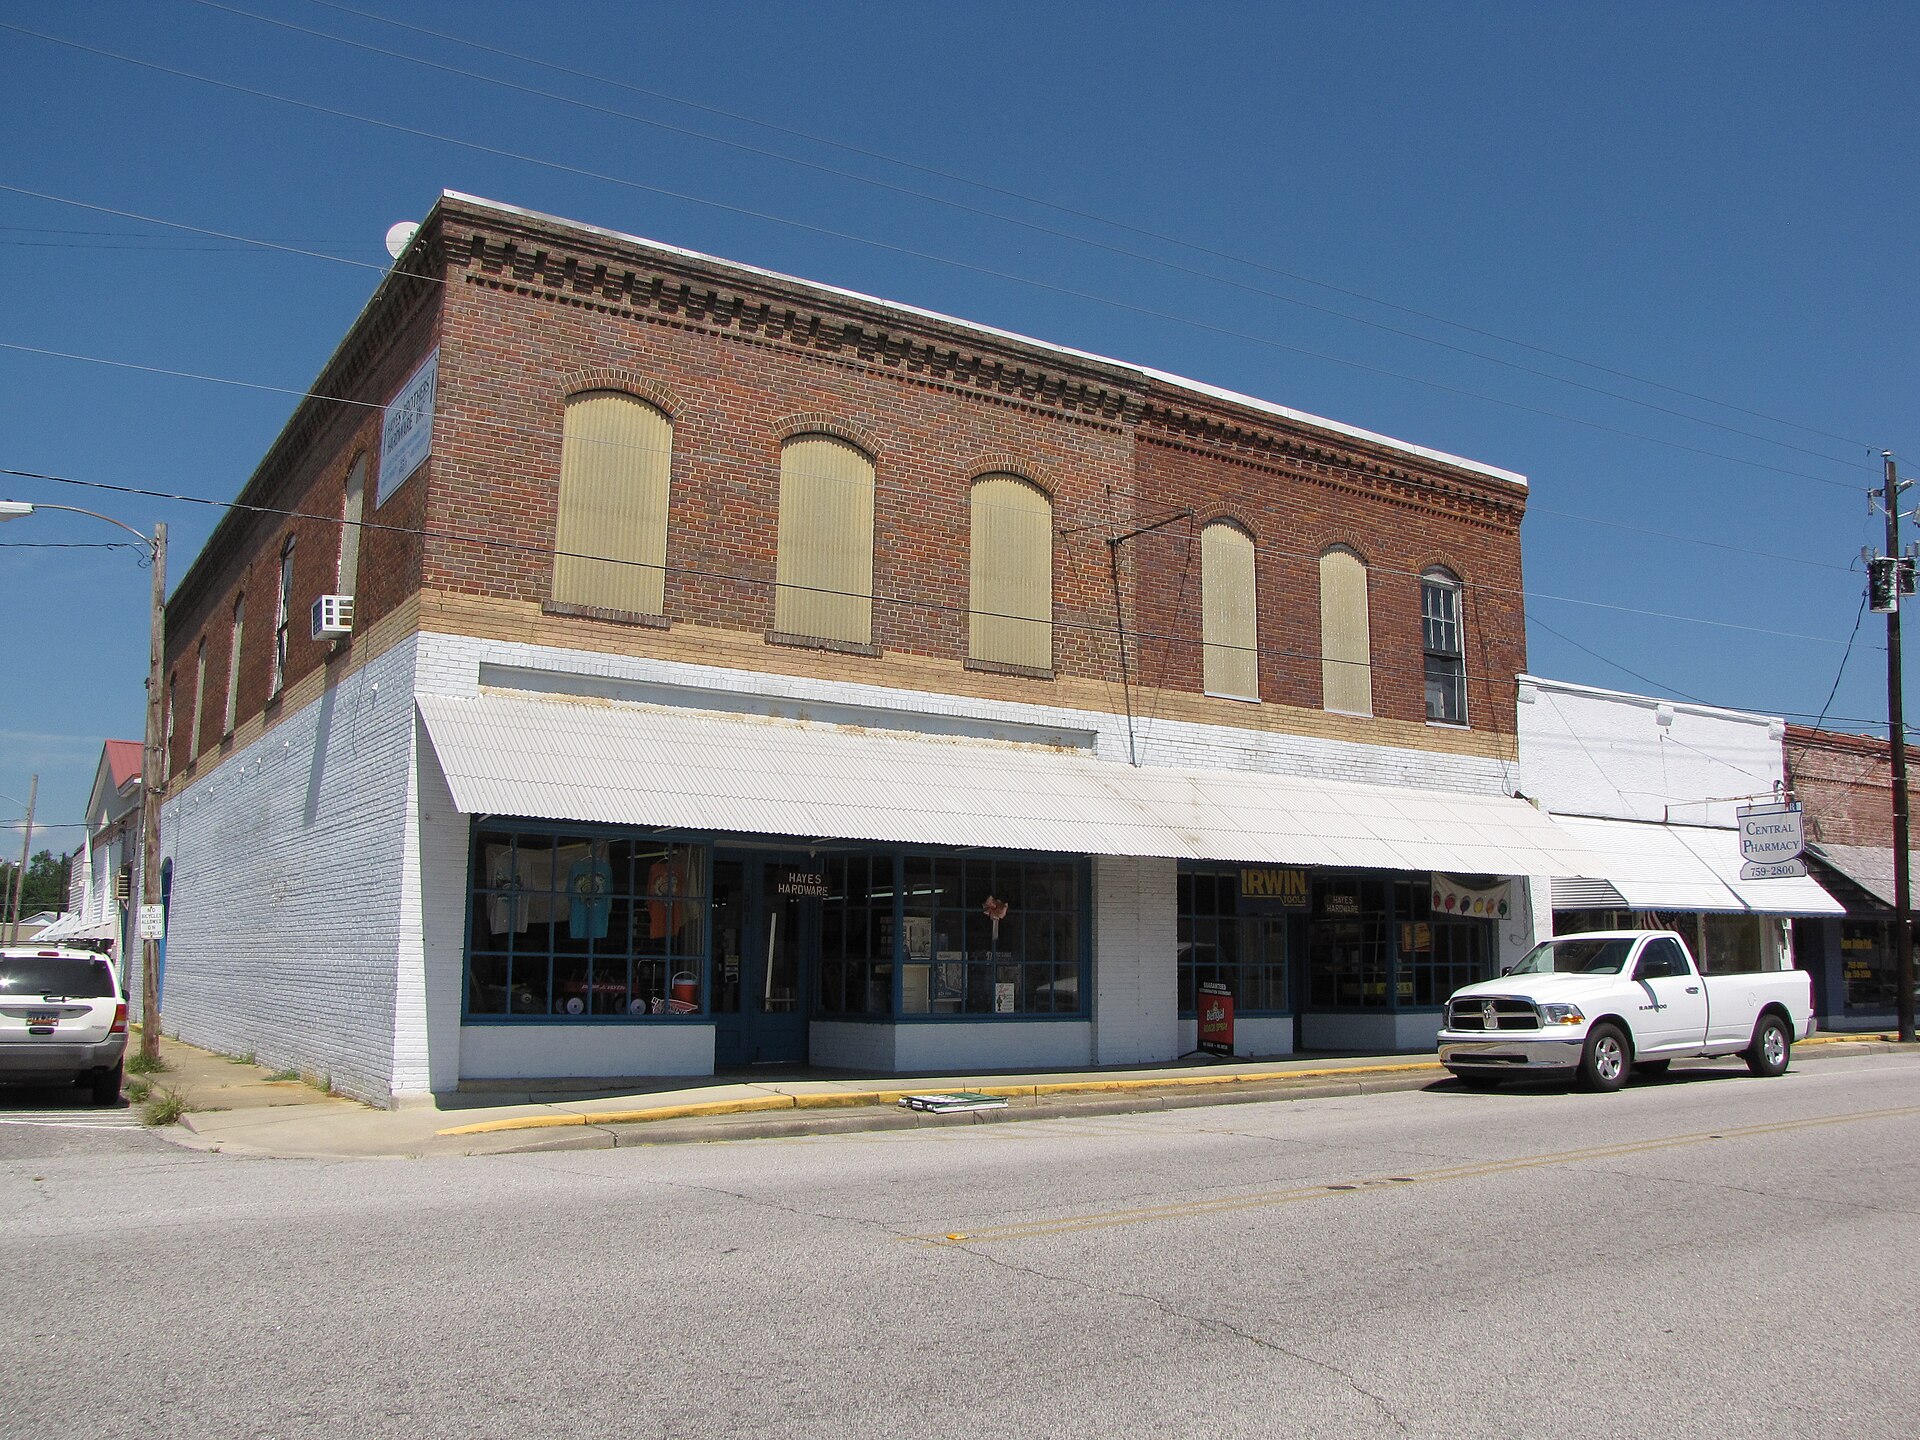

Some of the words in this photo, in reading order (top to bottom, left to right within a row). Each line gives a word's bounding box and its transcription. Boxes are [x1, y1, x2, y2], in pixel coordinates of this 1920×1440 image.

[1746, 822, 1795, 836] CENTRAL
[1743, 839, 1800, 853] PHARMACY
[1750, 865, 1794, 877] 759-2800
[789, 872, 822, 885] HAYES
[1241, 869, 1306, 895] IRWIN
[778, 883, 829, 897] HARDWARE
[1283, 895, 1306, 904] TOOLS
[1333, 896, 1353, 905] HAYES
[1326, 904, 1359, 914] HARDWARE
